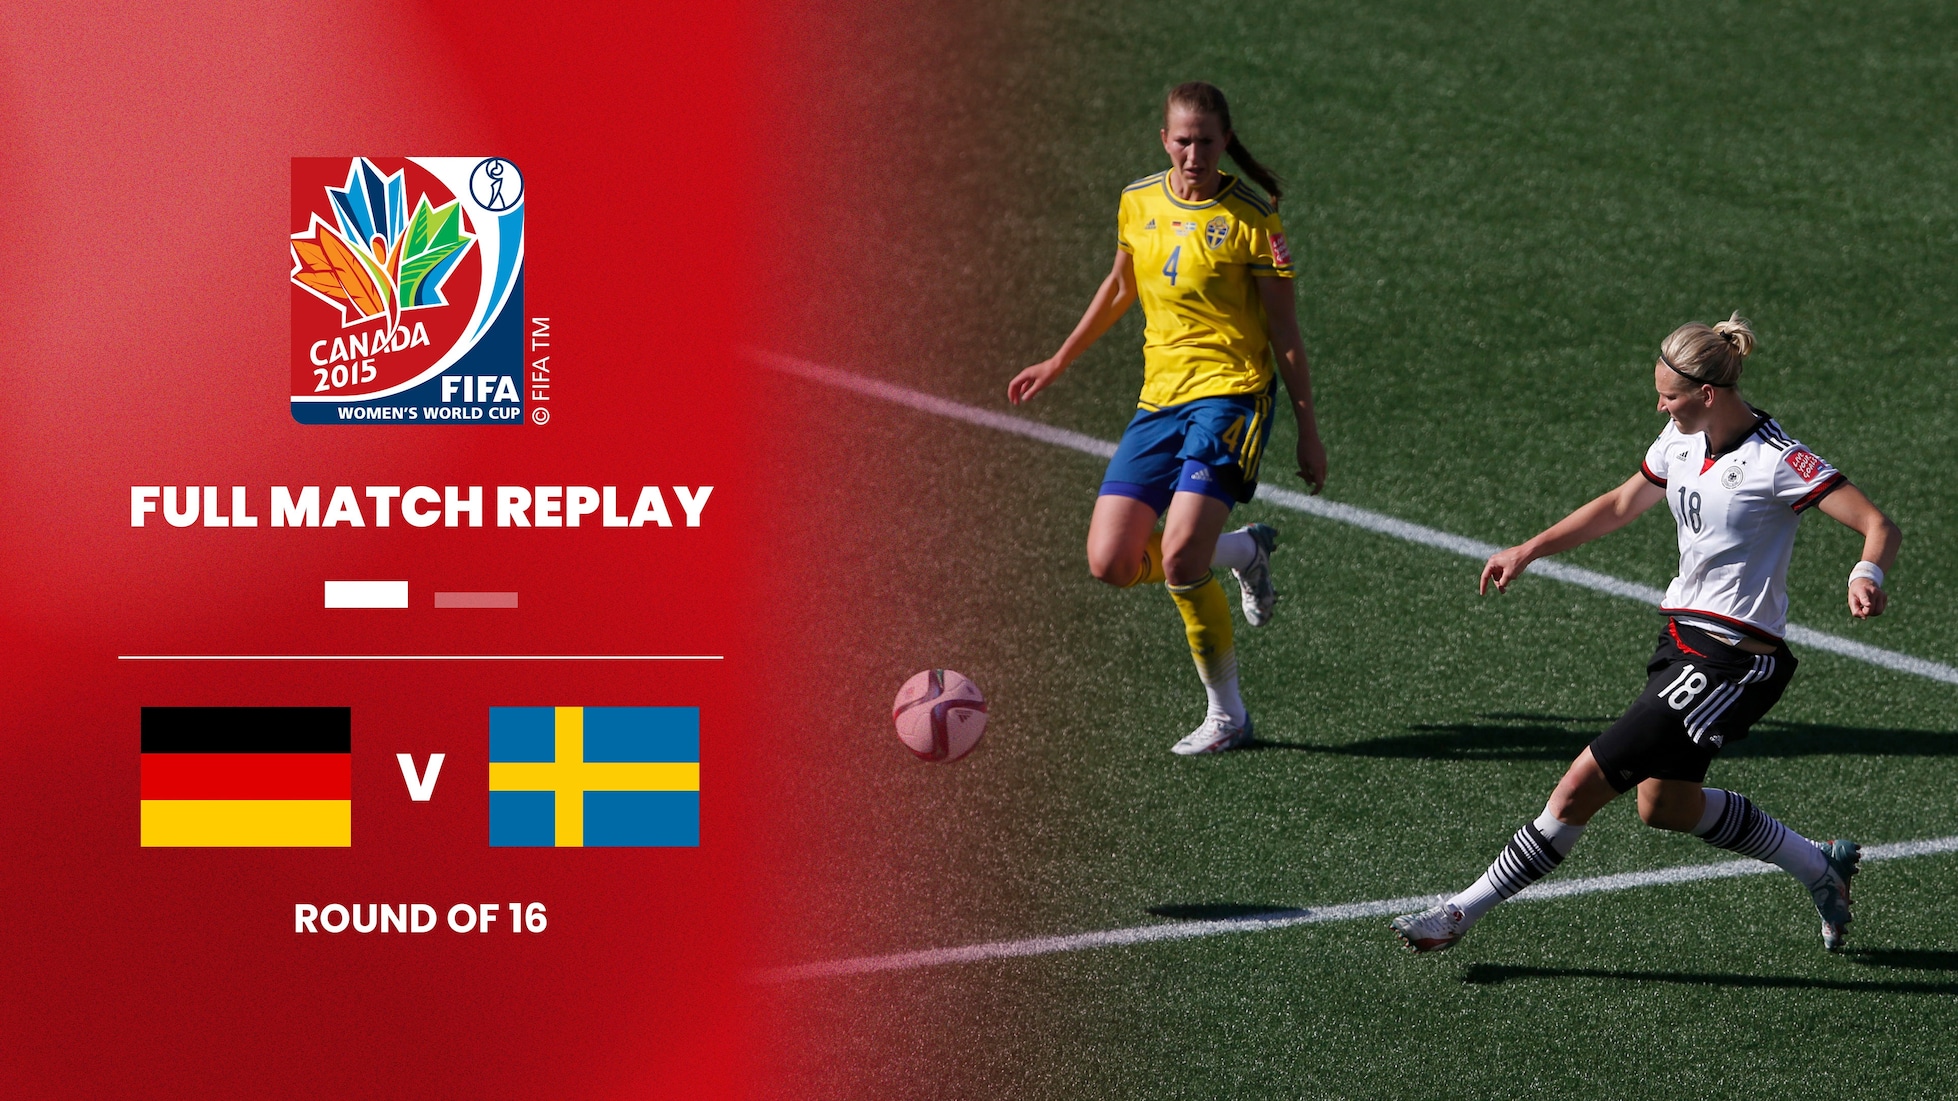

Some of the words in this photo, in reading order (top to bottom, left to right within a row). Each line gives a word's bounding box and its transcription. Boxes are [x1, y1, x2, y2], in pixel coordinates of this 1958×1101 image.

[1162, 245, 1181, 286] 4
[1222, 415, 1246, 453] 4
[1677, 486, 1702, 534] 18
[1657, 663, 1708, 710] 18
